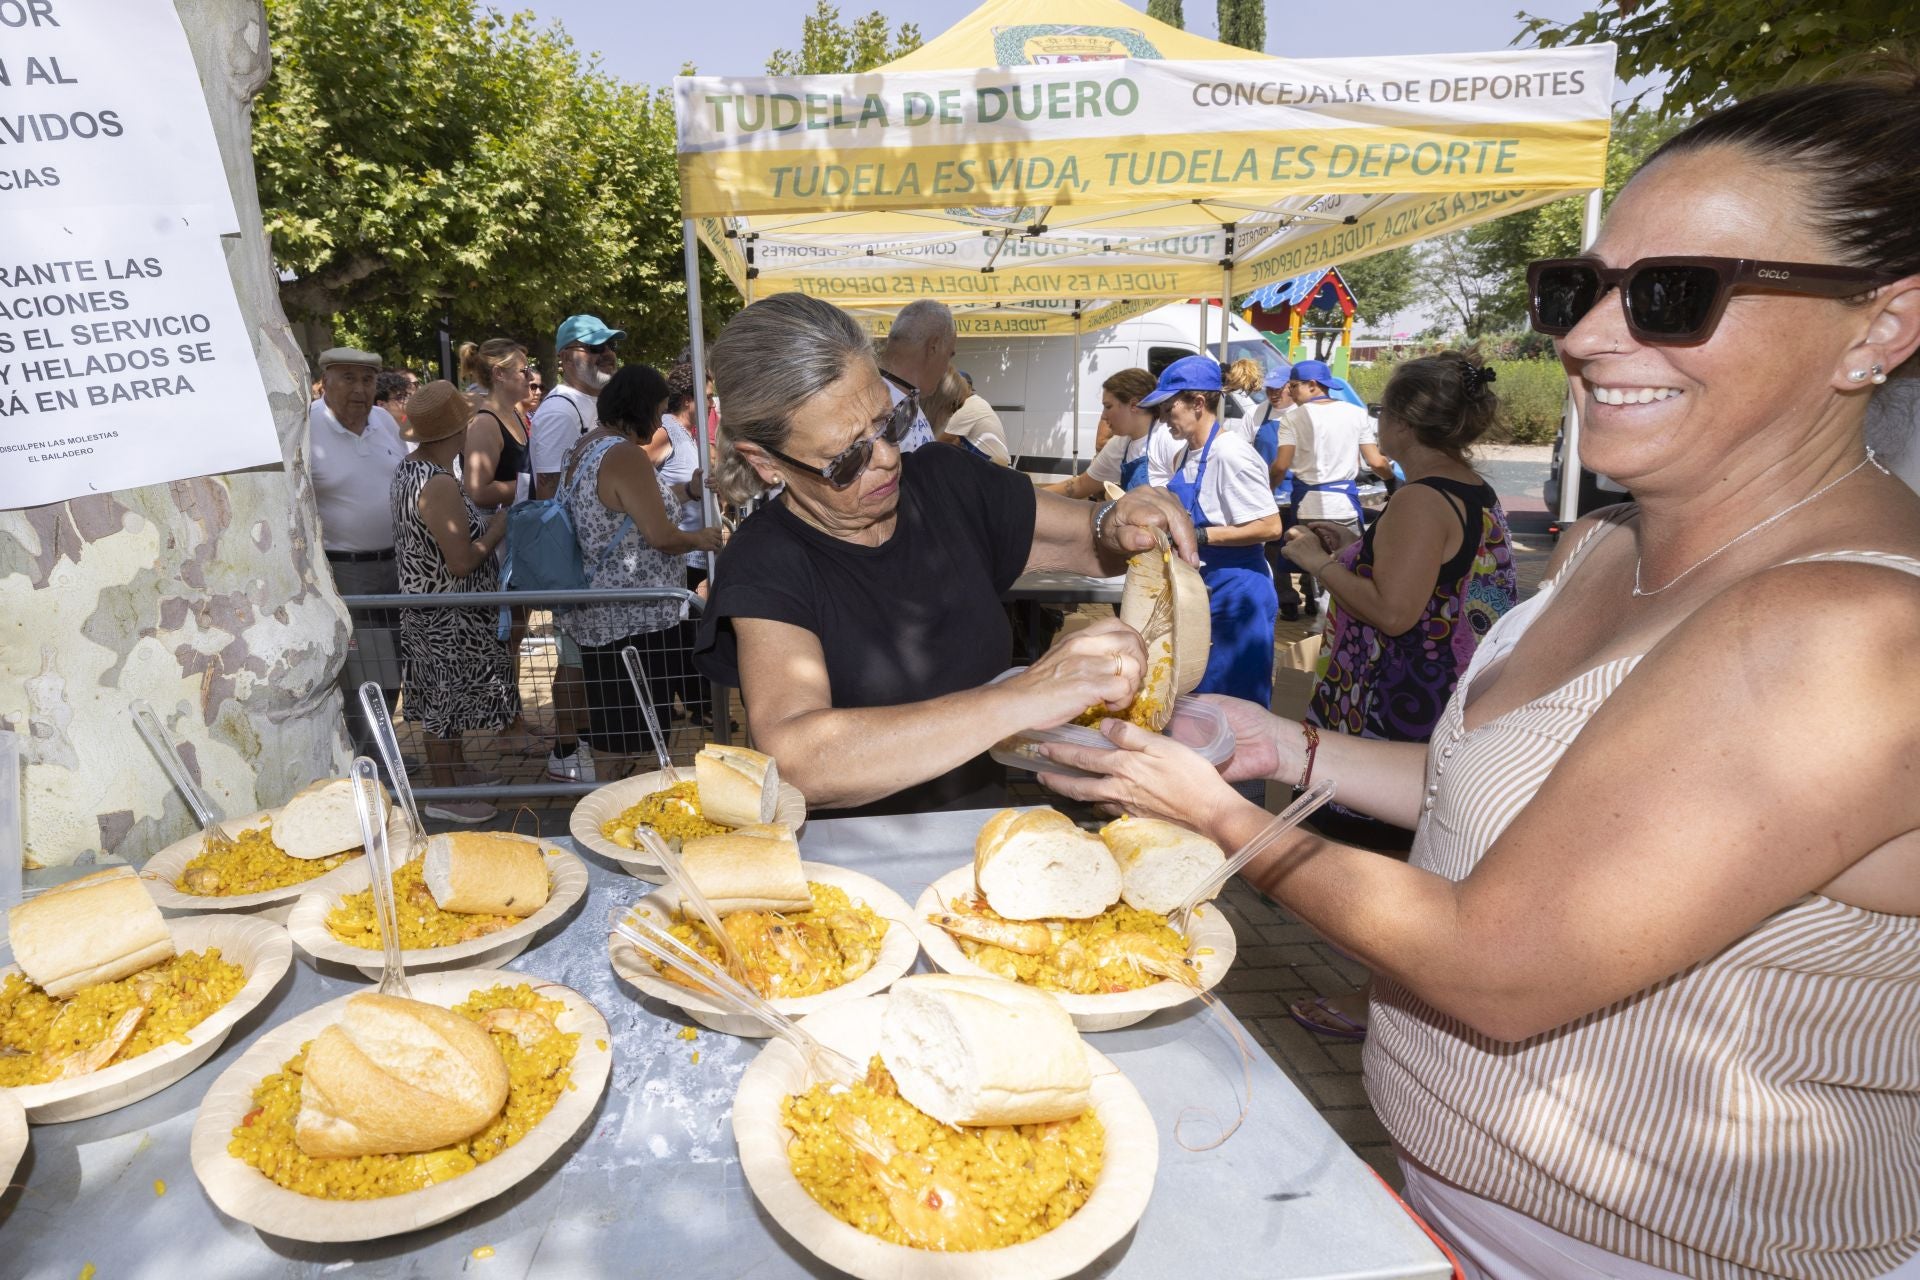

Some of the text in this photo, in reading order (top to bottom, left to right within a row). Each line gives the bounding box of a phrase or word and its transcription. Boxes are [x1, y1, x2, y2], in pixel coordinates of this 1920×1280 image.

[26, 56, 78, 85] AL
[1192, 70, 1585, 107] CONCEJALÍA DE DEPORTES
[705, 77, 1139, 132] TUDELA DE DUERO
[0, 110, 124, 145] VIDOS
[769, 139, 1520, 198] TUDELA ES VIDA, TUDELA ES DEPORTE
[105, 257, 162, 280] LAS
[23, 328, 65, 351] EL
[70, 313, 211, 346] SERVICIO
[21, 347, 170, 383] HELADOS
[177, 341, 216, 364] SE
[35, 388, 79, 412] EN
[86, 374, 196, 407] BARRA
[0, 430, 119, 454] DISCULPEN LAS MOLESTIAS
[28, 447, 94, 463] EL BAILADERO
